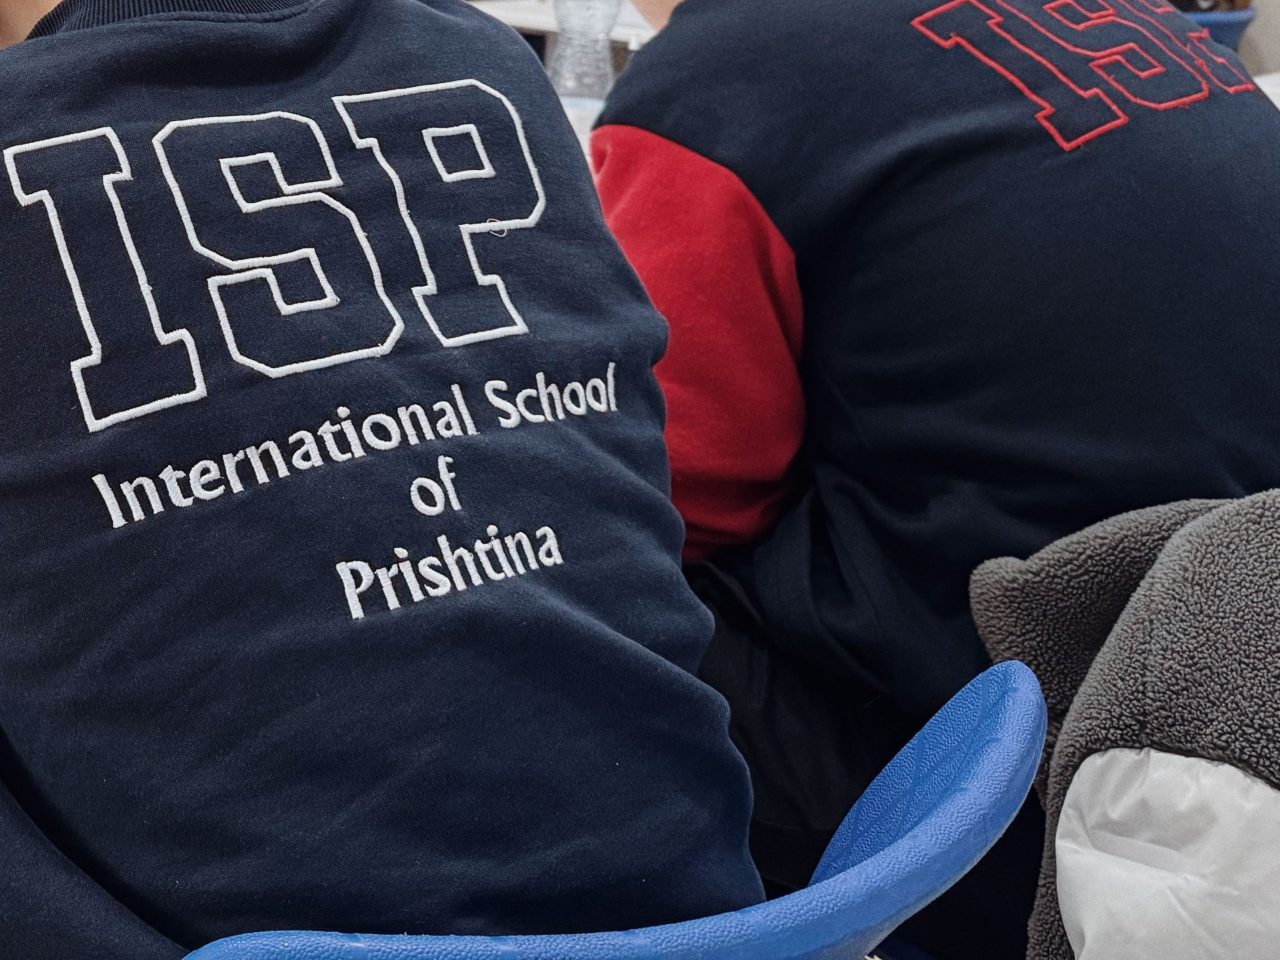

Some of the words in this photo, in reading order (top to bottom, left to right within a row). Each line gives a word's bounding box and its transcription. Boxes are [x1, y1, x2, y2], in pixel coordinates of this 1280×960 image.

[4, 78, 546, 432] ISP
[91, 384, 481, 528] International
[484, 361, 619, 430] School
[410, 455, 462, 517] of
[335, 524, 564, 619] Prishtina
